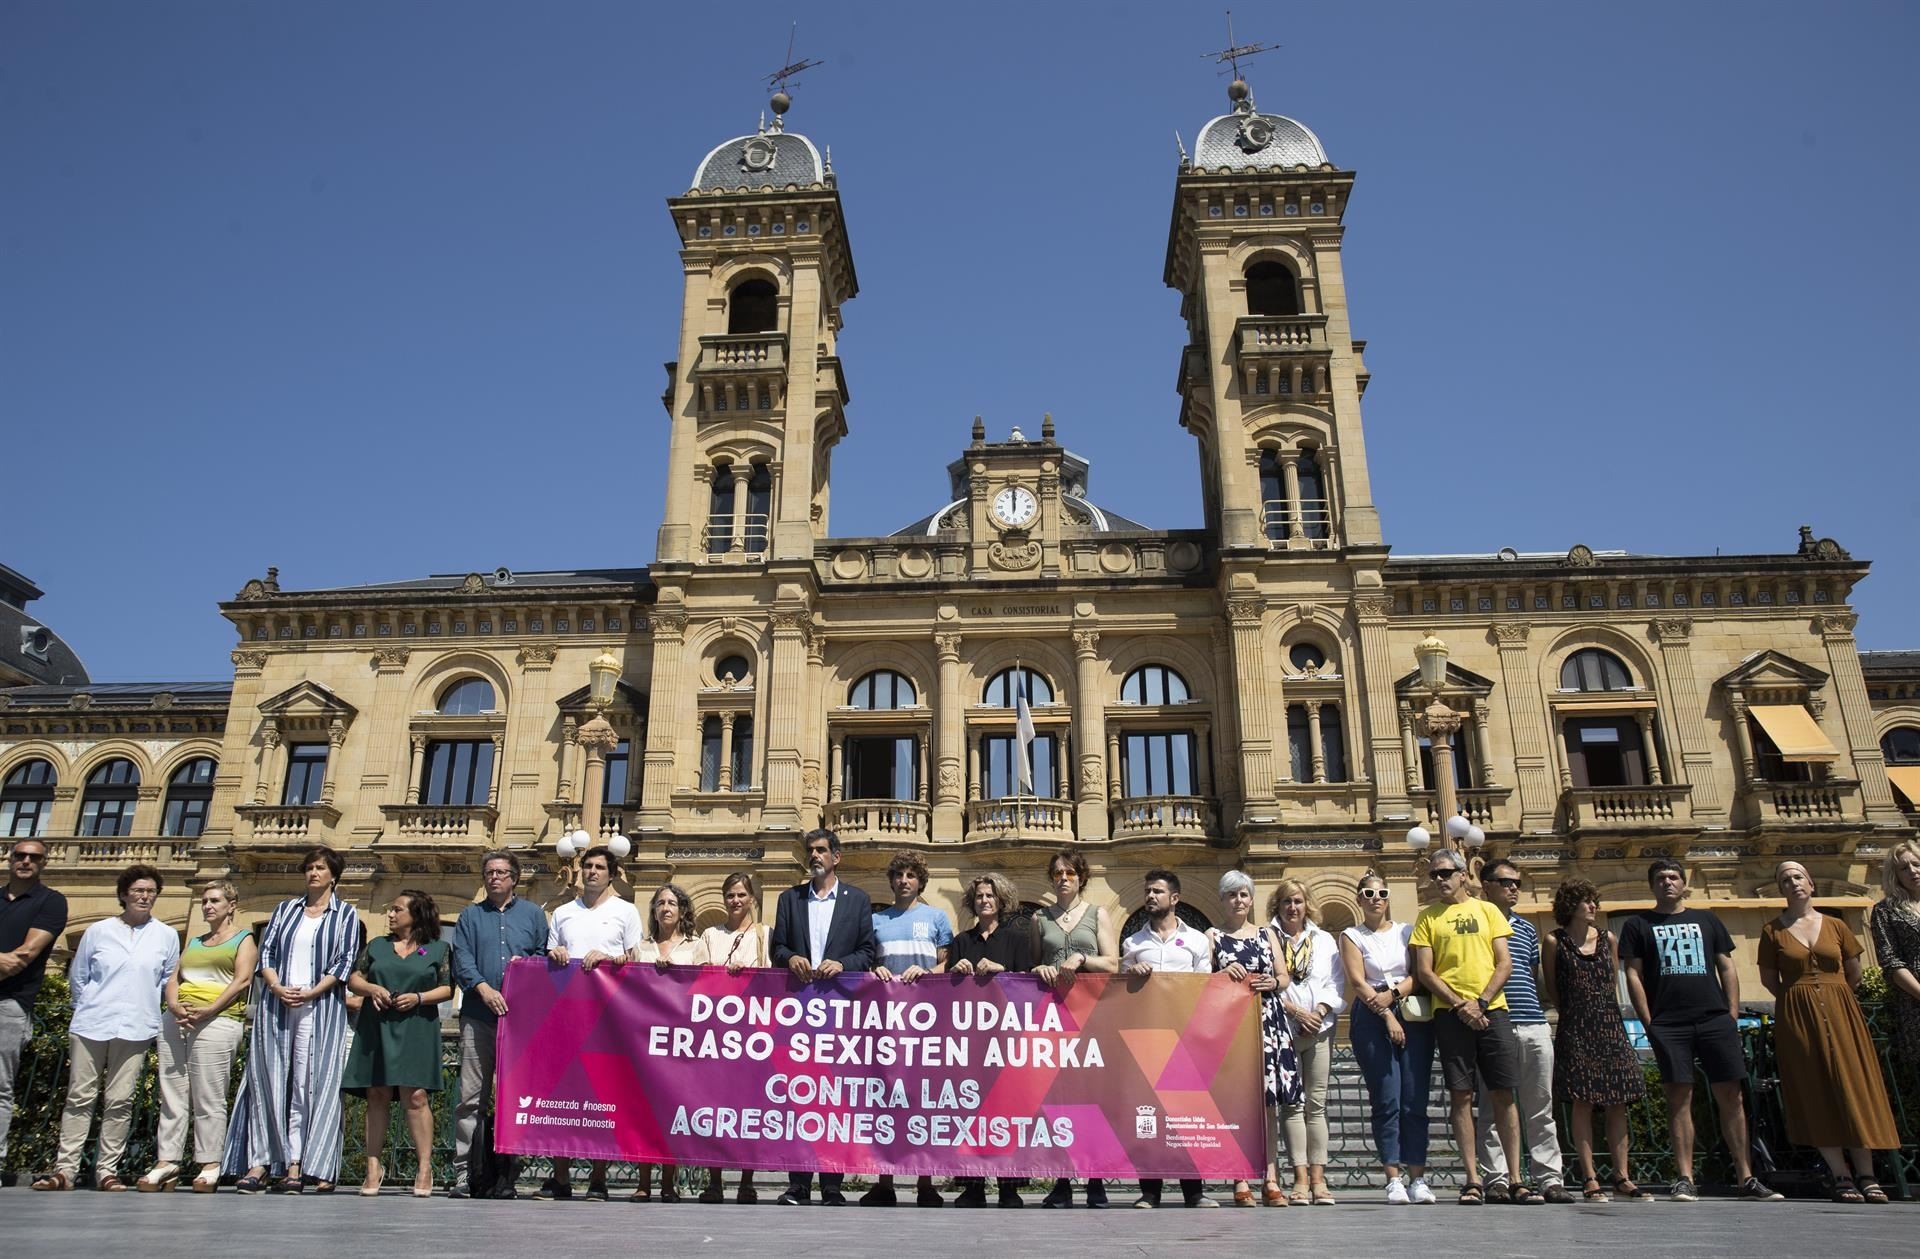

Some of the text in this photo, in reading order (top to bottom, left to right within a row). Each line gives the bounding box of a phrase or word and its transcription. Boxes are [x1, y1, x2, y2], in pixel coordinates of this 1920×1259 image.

[971, 605, 1061, 615] CASA CONSISTORIAL
[1652, 923, 1702, 940] GORA
[1656, 937, 1706, 968] KAI
[690, 994, 1064, 1033] DONOSTIAKO UDALA
[648, 1026, 1105, 1068] ERASO SEXISTEN AURKA
[535, 1098, 616, 1112] #ezezetzda #noesno
[765, 1074, 980, 1110] CONTRA LAS
[530, 1115, 616, 1128] Berdintasuna Donostia
[670, 1105, 1075, 1148] AGRESIONES SEXISTAS
